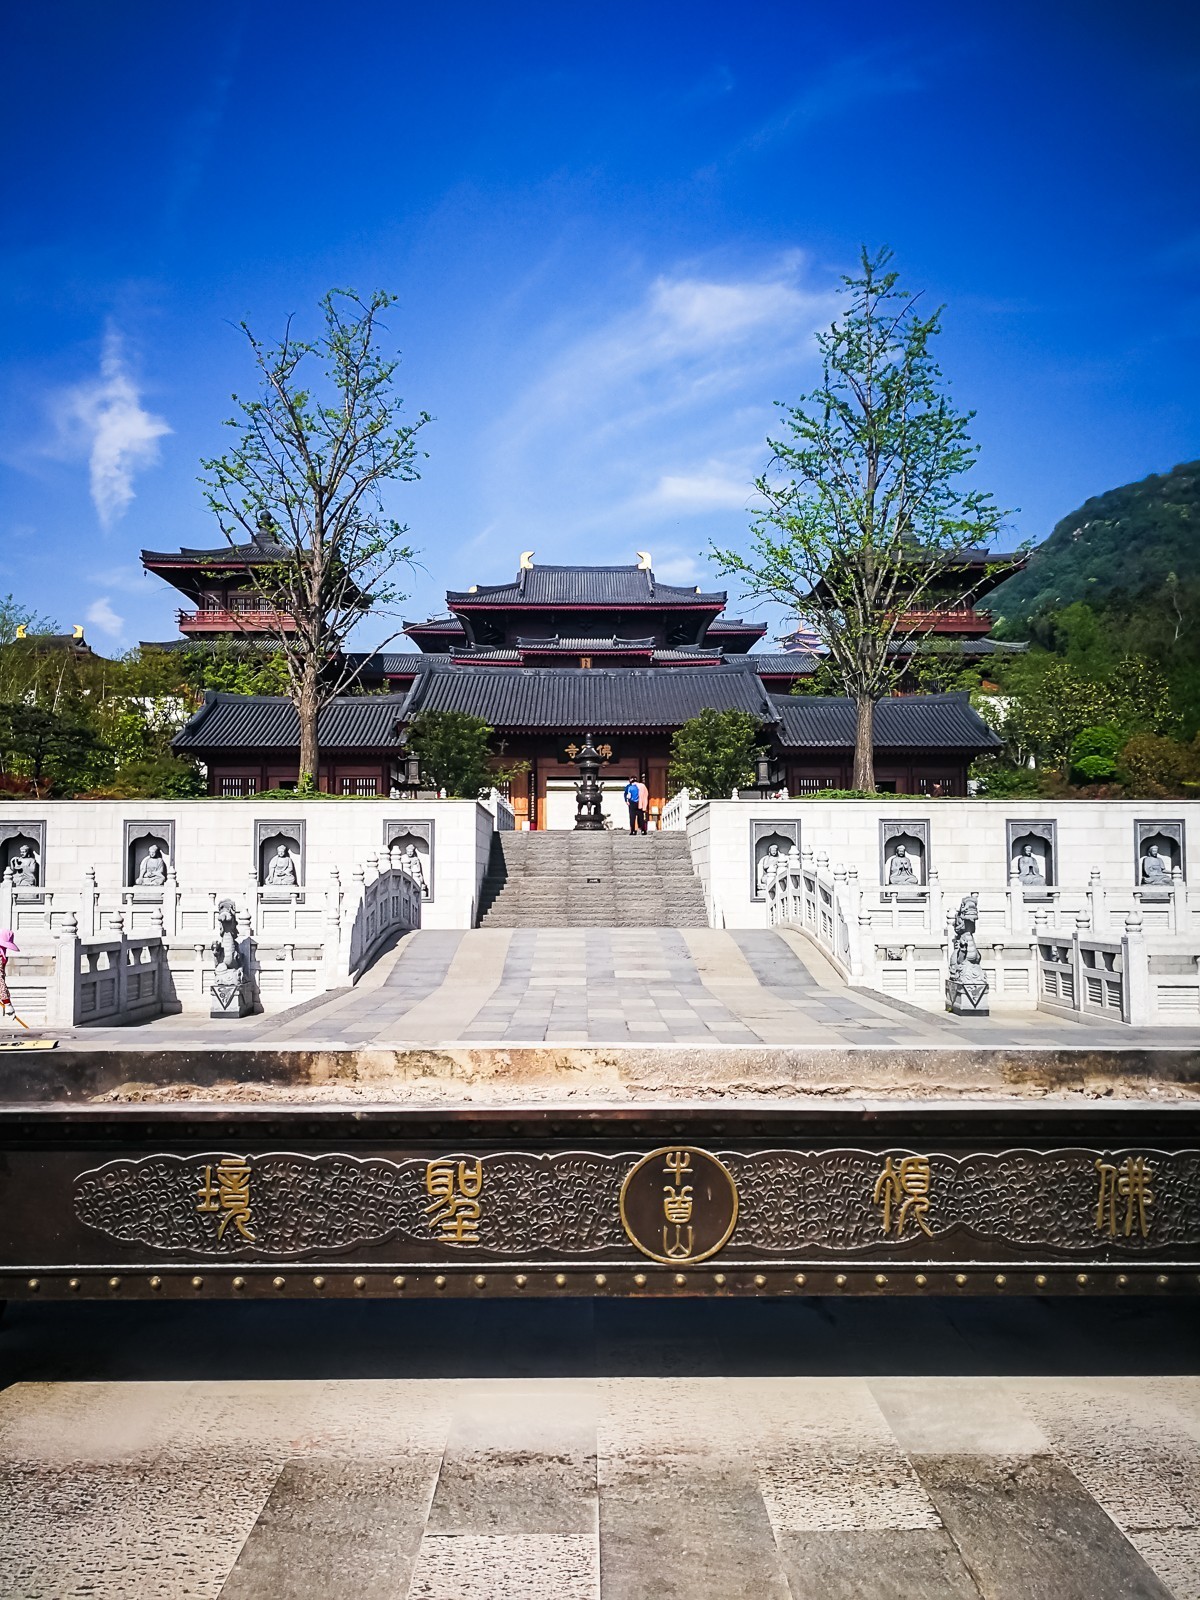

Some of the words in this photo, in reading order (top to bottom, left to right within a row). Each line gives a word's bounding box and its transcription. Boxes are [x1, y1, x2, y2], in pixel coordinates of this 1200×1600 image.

[564, 743, 613, 759] 佛寺
[663, 1152, 694, 1258] 牛首山
